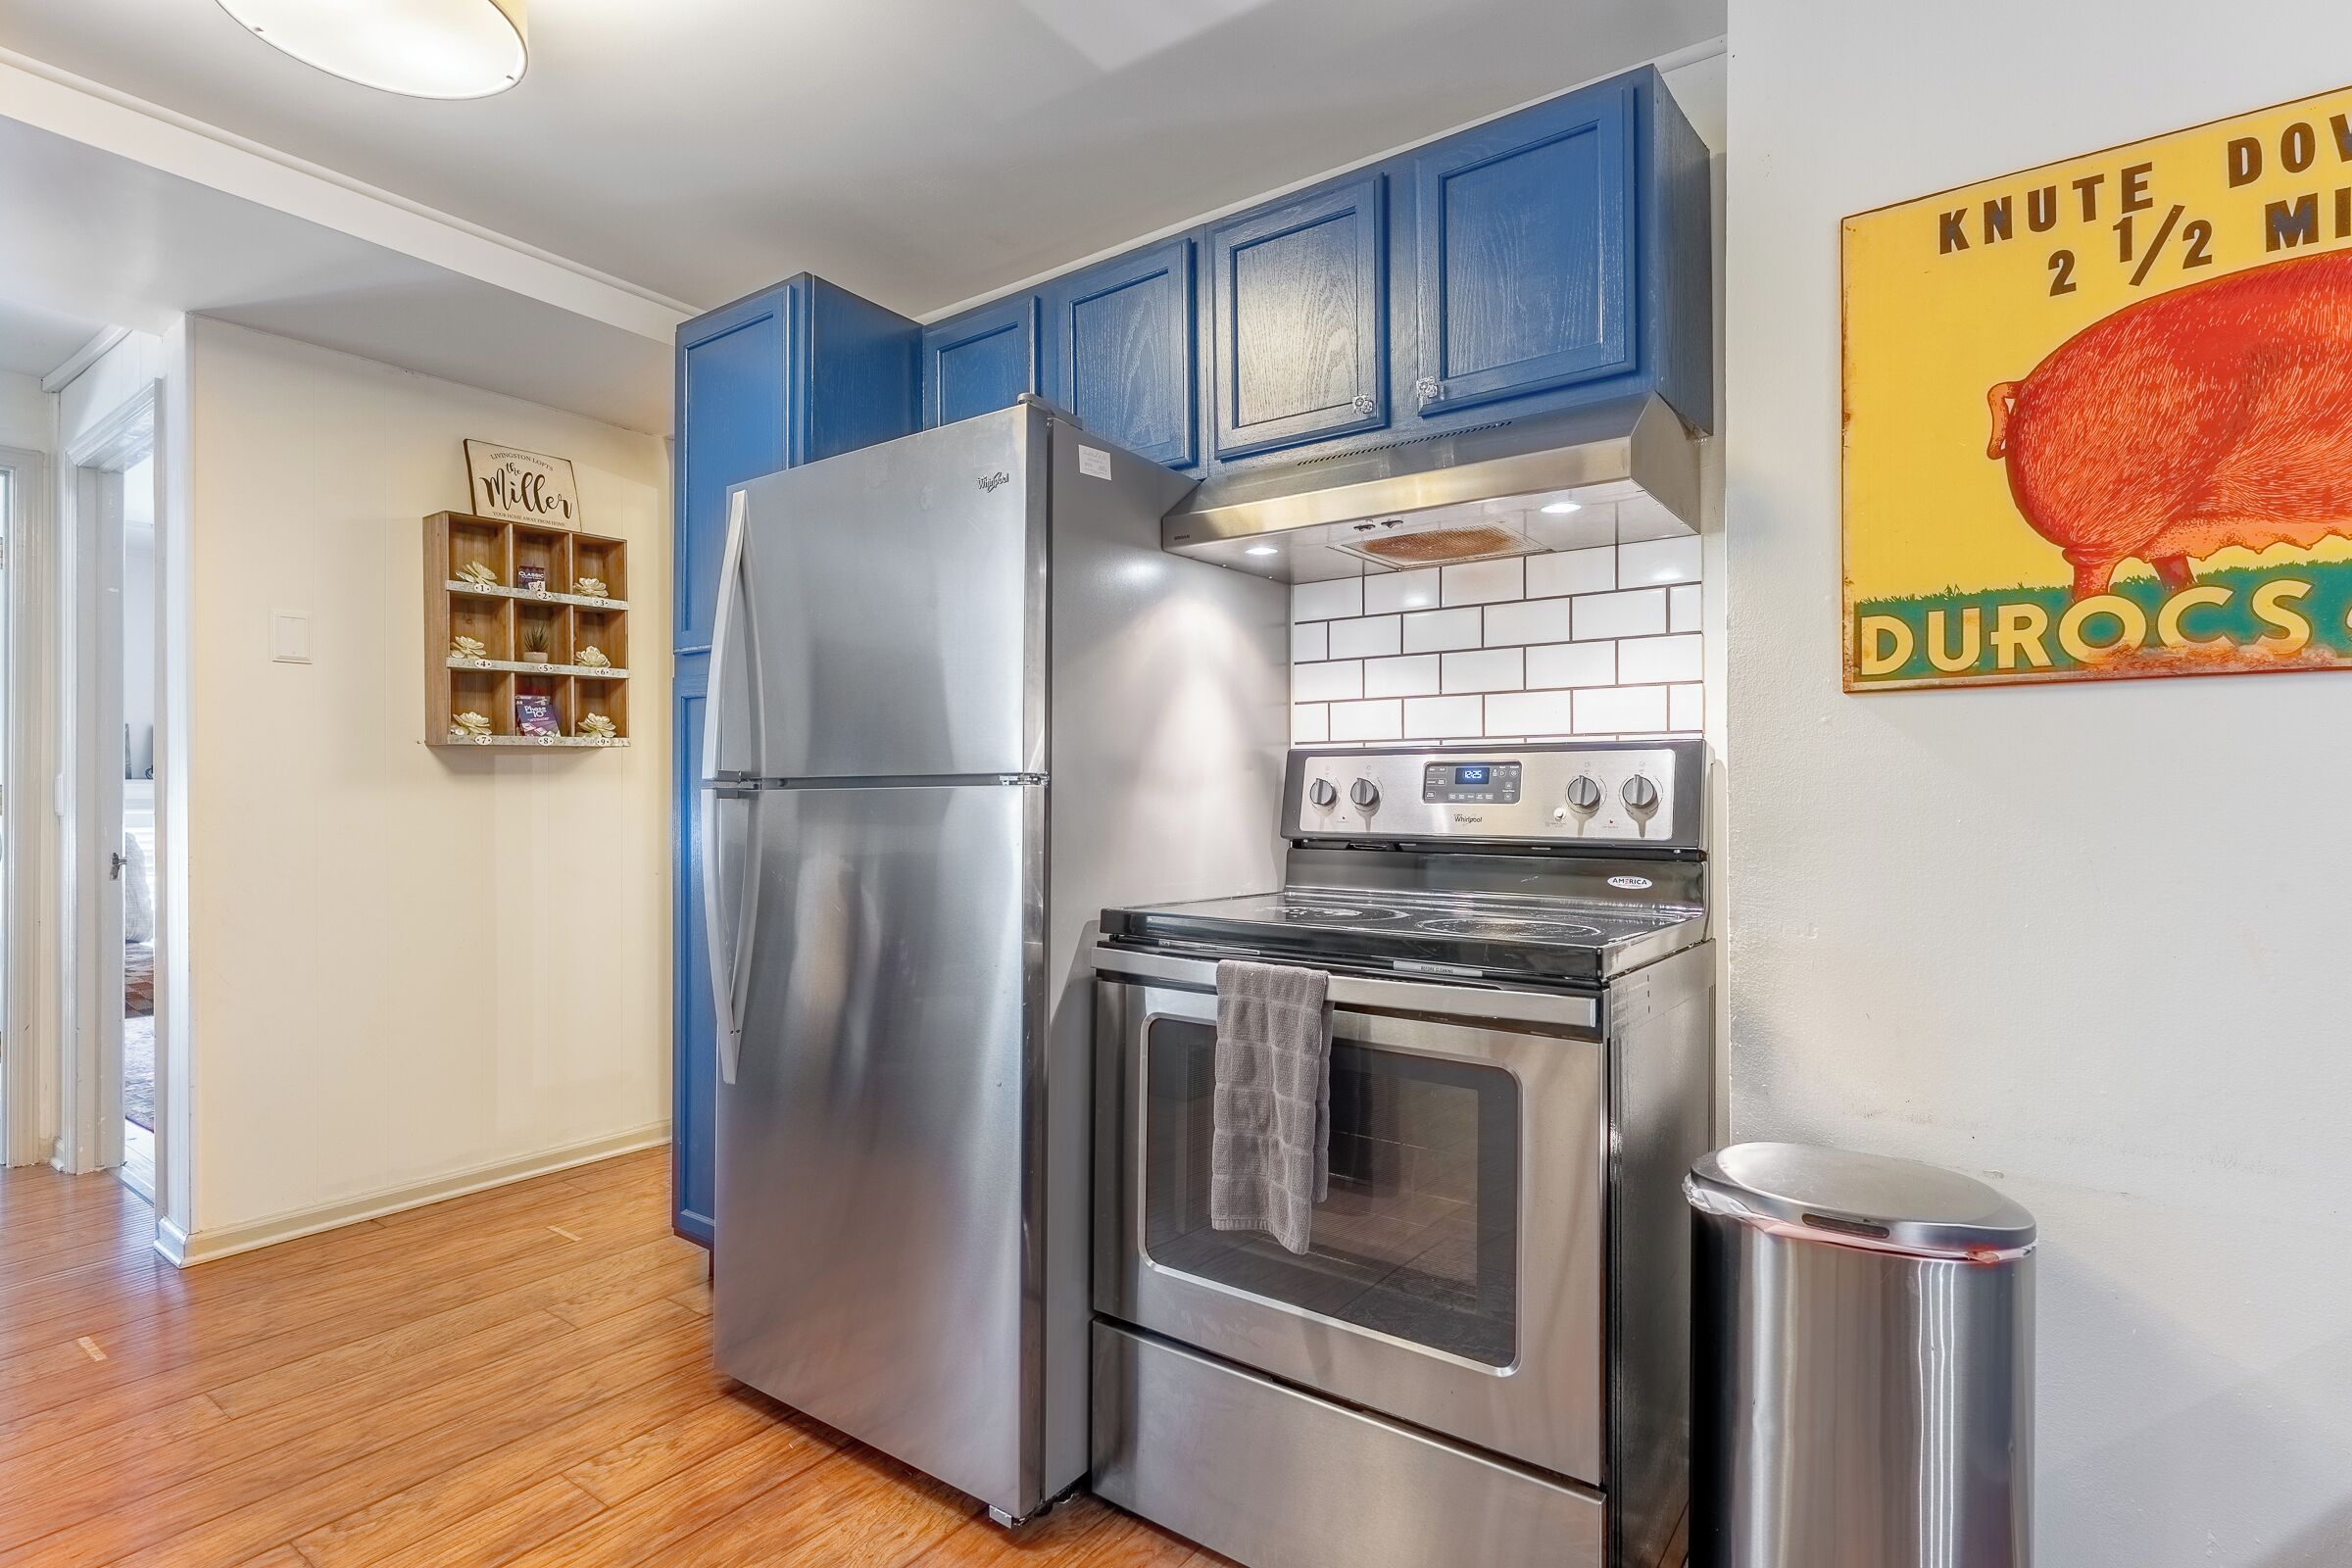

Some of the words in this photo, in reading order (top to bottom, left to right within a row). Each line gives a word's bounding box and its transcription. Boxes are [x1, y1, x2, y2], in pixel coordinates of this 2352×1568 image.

[1938, 161, 2154, 255] KNUTE
[2047, 249, 2078, 297] 2
[2112, 204, 2213, 287] 1/2
[2264, 186, 2352, 253] MI
[490, 452, 531, 462] LIVINGSTON
[532, 458, 554, 471] LOFTS
[506, 462, 522, 476] the
[478, 467, 573, 519] Miller
[976, 470, 1009, 493] Whirlpool
[1860, 579, 2314, 676] DUROCS
[1454, 815, 1483, 824] Whirlpool
